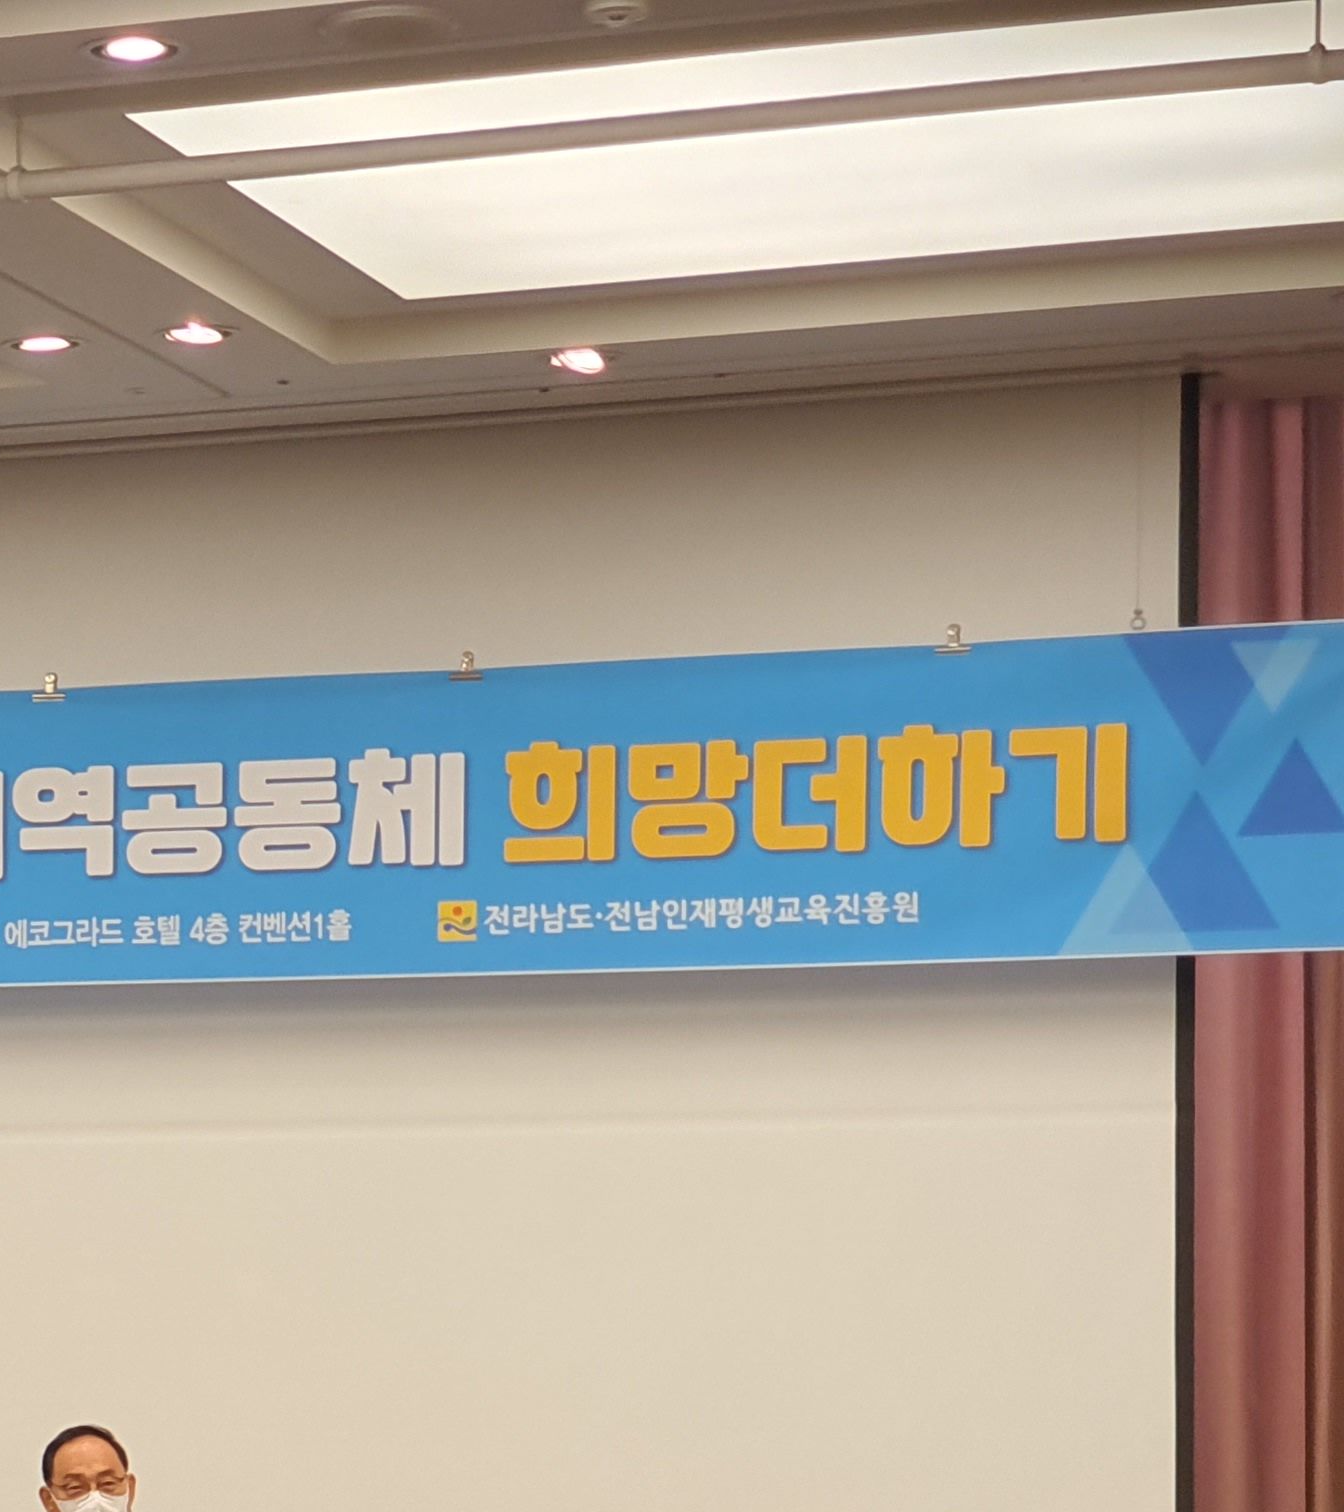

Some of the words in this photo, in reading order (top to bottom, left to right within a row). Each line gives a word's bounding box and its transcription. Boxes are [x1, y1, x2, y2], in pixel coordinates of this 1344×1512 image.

[503, 723, 1128, 863] 희망더하기
[4, 916, 124, 950] 에코그라드
[131, 914, 181, 946] 호텔
[189, 912, 230, 946] 4층
